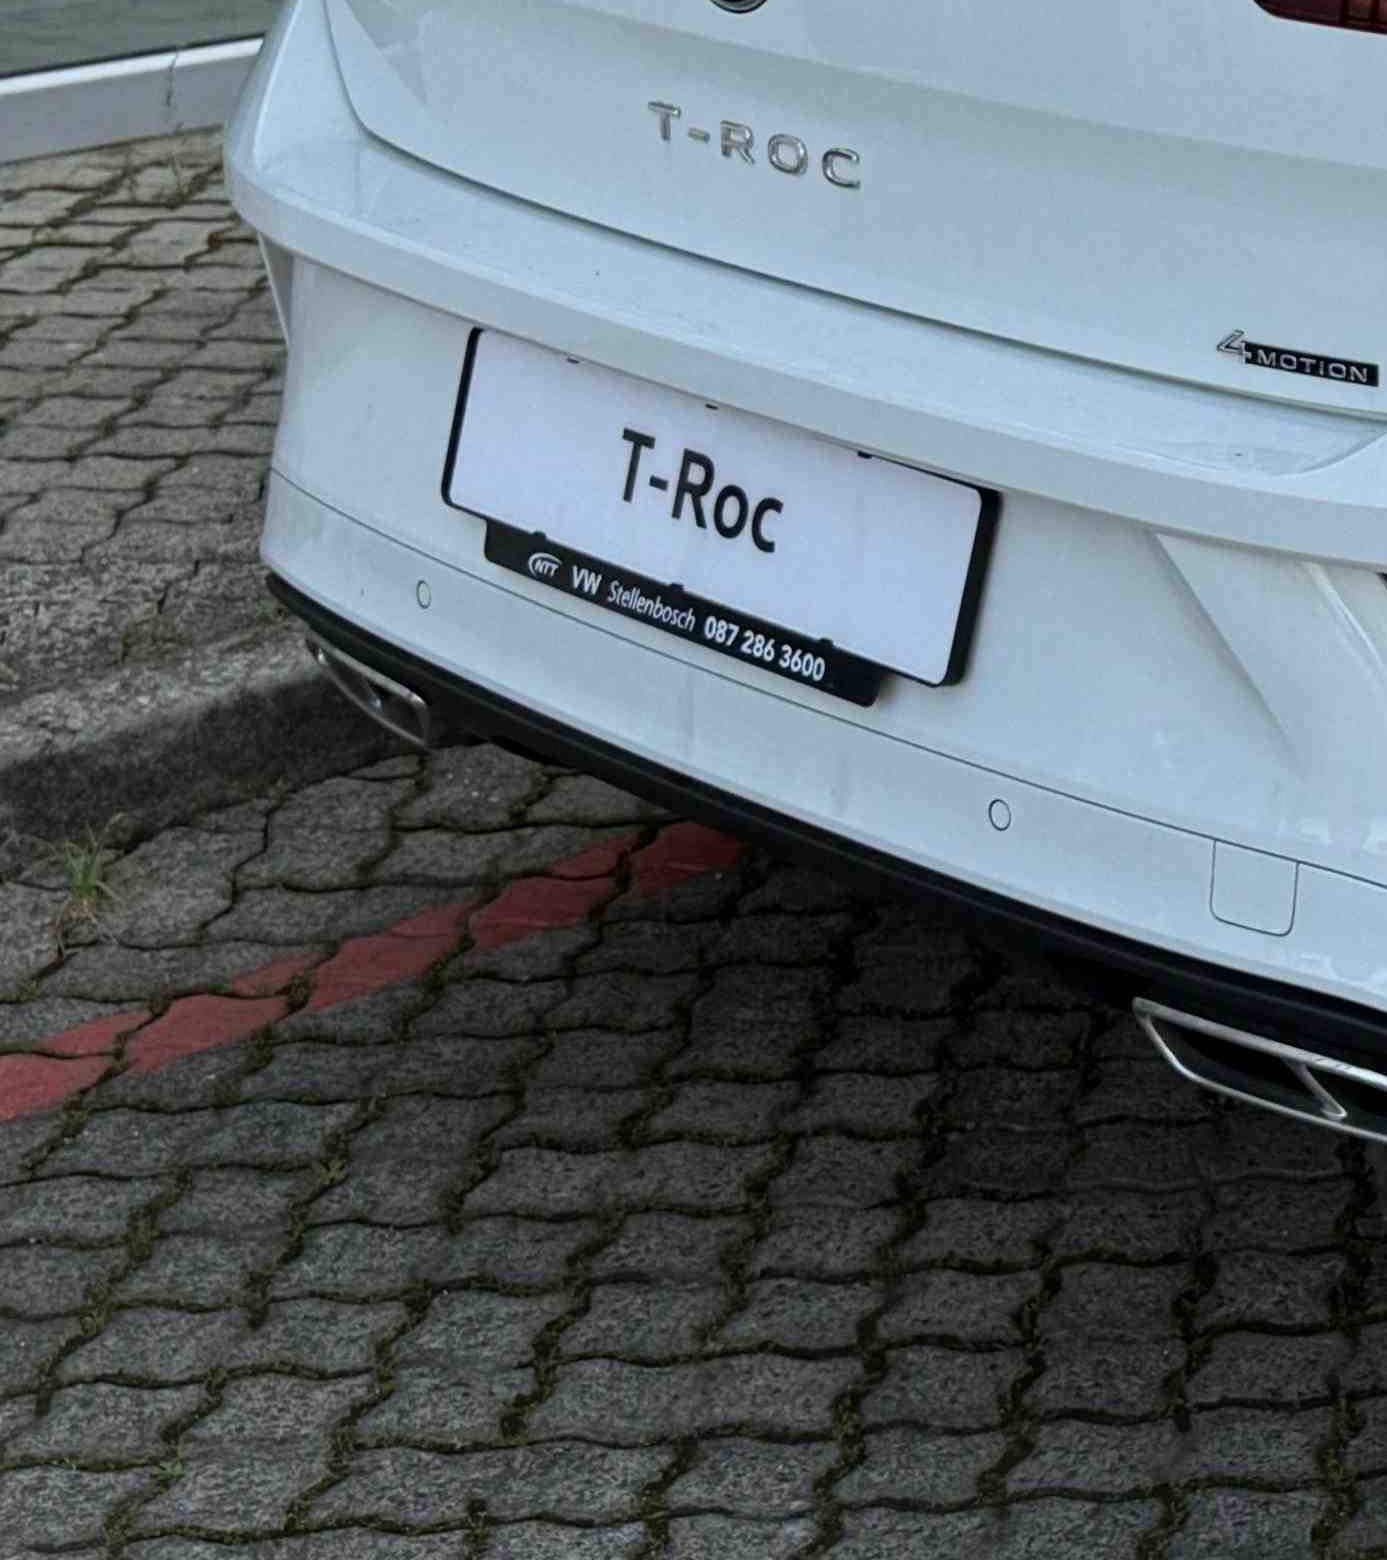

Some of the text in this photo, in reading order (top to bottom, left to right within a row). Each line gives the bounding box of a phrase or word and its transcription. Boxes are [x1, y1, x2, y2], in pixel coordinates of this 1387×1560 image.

[648, 101, 861, 190] T-ROC
[622, 427, 784, 553] T-Roc
[532, 557, 826, 681] NTT VW Stellenbosch 087 286 3600
